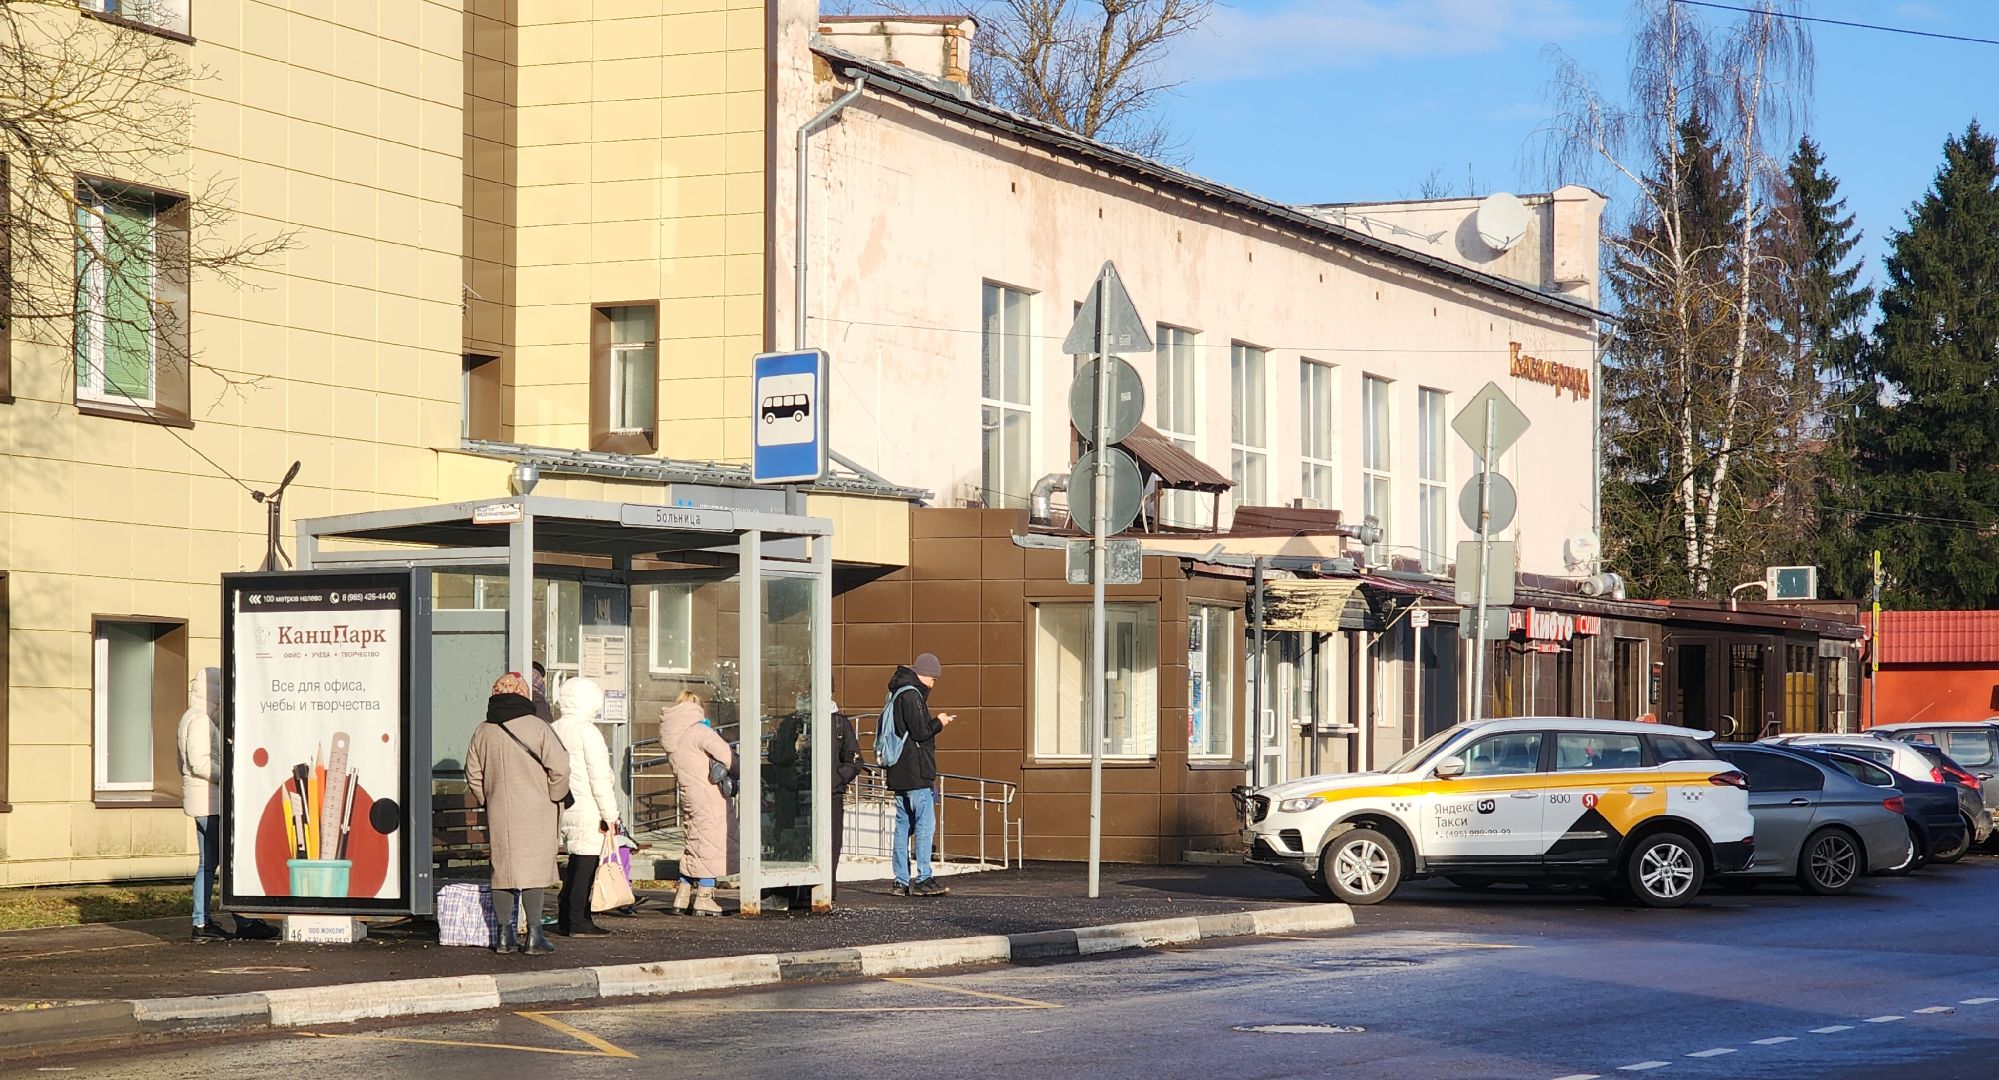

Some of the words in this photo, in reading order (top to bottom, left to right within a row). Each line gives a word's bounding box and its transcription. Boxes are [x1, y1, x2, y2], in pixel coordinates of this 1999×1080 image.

[656, 509, 701, 525] Больница
[263, 595, 275, 603] 100
[276, 595, 299, 603] метров
[300, 594, 323, 602] налево
[342, 593, 347, 602] 8
[347, 593, 363, 602] (985)
[364, 592, 397, 601] 426-44-00
[1580, 615, 1601, 634] СУШИ
[278, 625, 387, 648] КанцПарк
[271, 679, 295, 692] Все
[298, 681, 321, 693] для
[324, 678, 366, 694] офиса,
[260, 698, 296, 713] учебы
[299, 701, 307, 710] и
[310, 700, 381, 713] творчества
[1550, 794, 1571, 804] 800
[1585, 794, 1594, 806] Я
[1434, 803, 1474, 815] Яндекс
[1435, 816, 1468, 828] Такси
